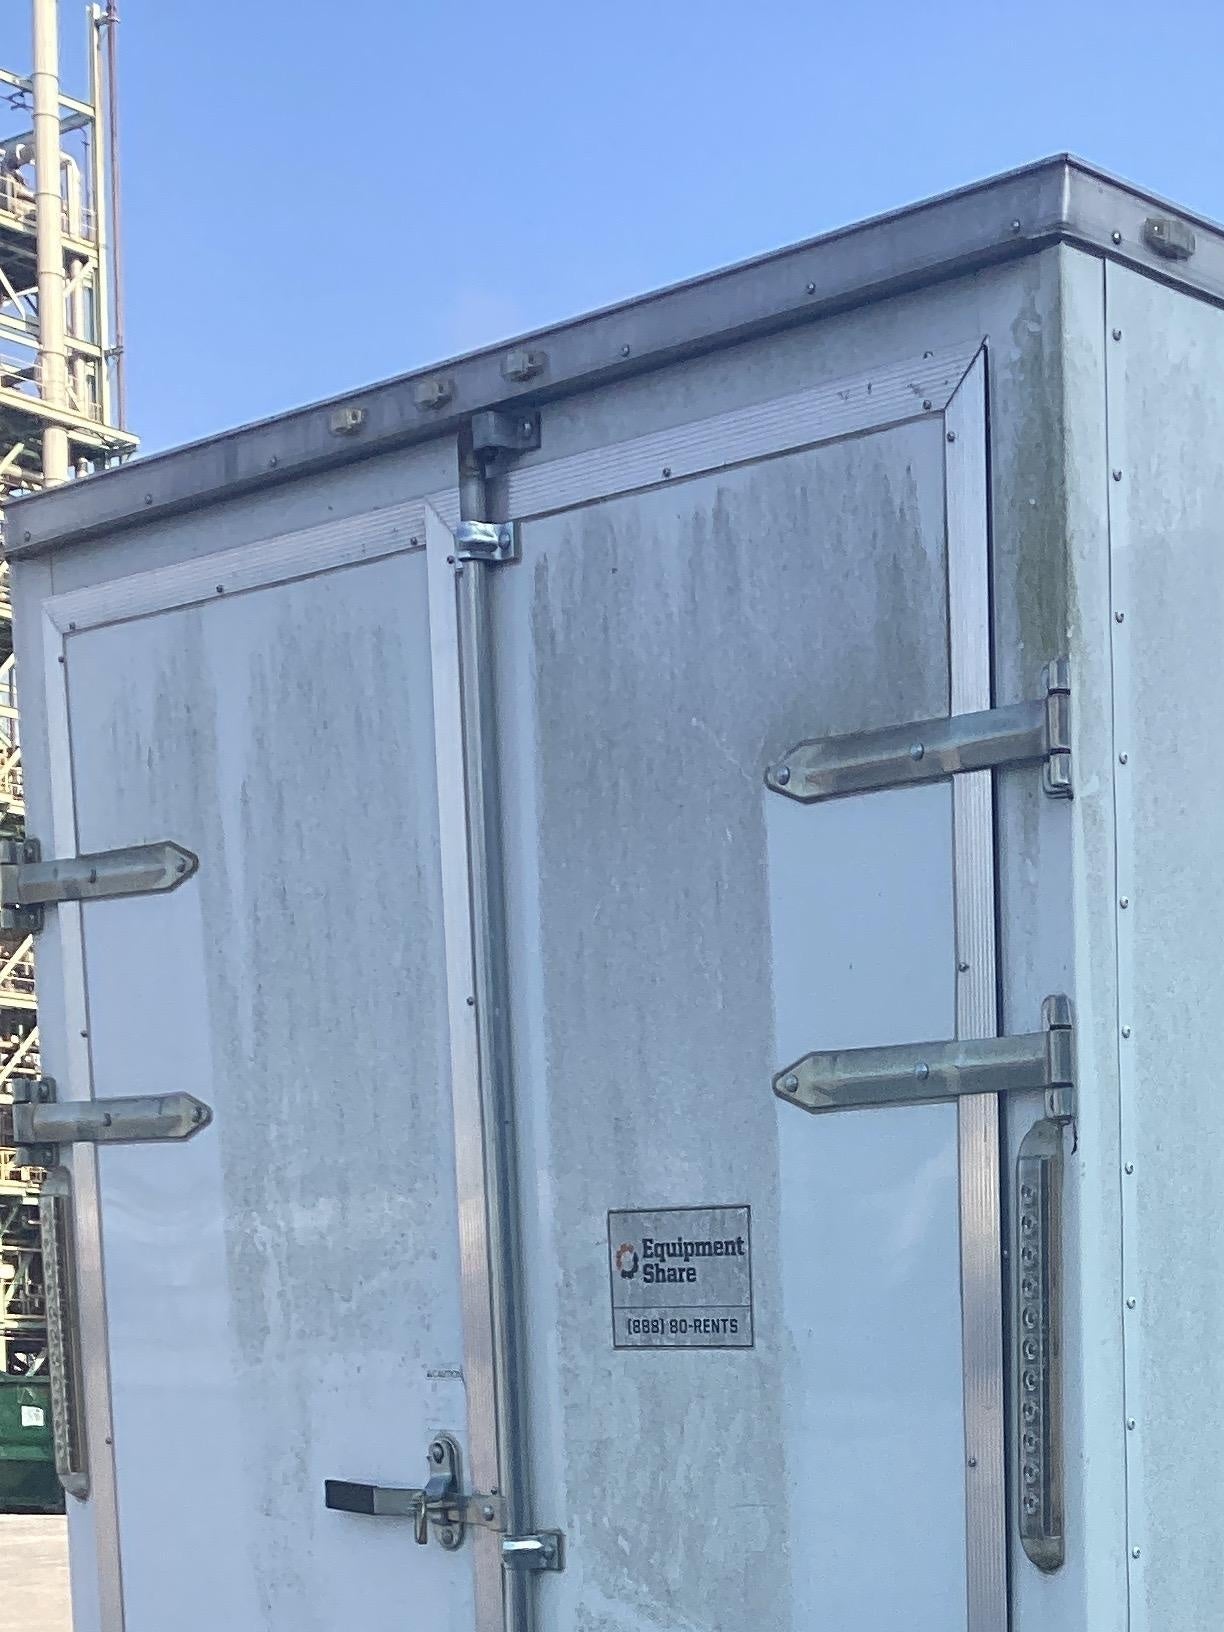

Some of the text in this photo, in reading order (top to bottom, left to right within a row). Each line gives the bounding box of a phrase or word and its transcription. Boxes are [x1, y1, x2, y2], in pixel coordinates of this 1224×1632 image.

[642, 1236, 746, 1263] Equipment
[643, 1263, 698, 1284] Share
[669, 1318, 739, 1334] 80-RENTS
